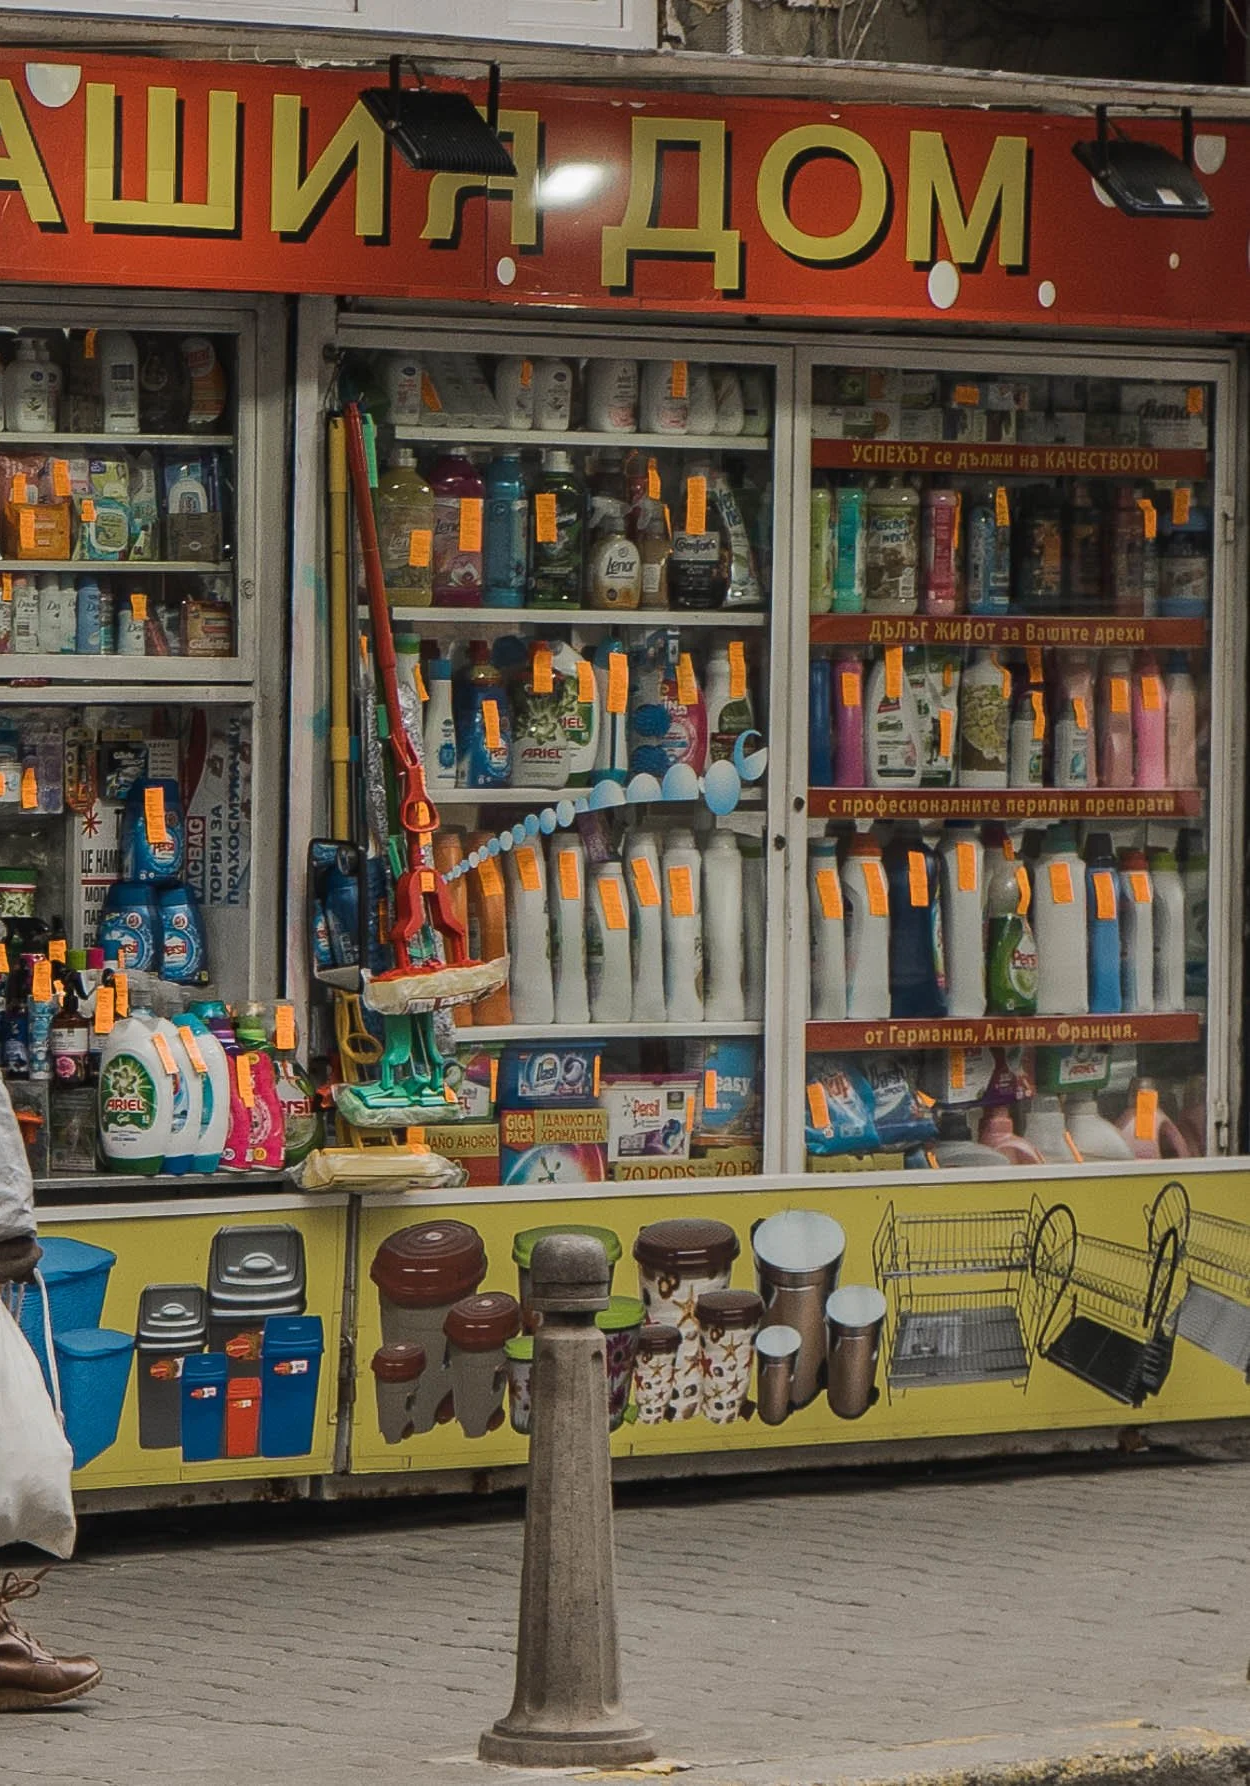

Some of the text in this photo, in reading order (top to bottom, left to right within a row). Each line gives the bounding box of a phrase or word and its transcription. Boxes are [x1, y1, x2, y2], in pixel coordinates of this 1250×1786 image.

[601, 117, 1029, 292] ДОМ
[852, 444, 929, 465] УСПЕХЪТ
[934, 451, 952, 466] се
[957, 453, 1014, 471] дължи
[1019, 454, 1040, 469] на
[934, 622, 996, 641] ЖИВОТ
[1002, 627, 1020, 641] за
[1026, 623, 1089, 642] Вашите
[1094, 625, 1146, 645] дрехи
[521, 748, 563, 760] ARIEL
[842, 794, 1001, 817] професионалните
[1005, 797, 1080, 815] перилни
[1085, 797, 1175, 816] препарати
[209, 804, 223, 903] ТОРБИ ЗА
[864, 1020, 1138, 1048] от Германия, Англия, Франция.
[106, 1097, 145, 1112] ARIEL
[281, 1096, 312, 1114] ersil
[506, 1113, 534, 1130] GIGA
[506, 1130, 534, 1143] PACK
